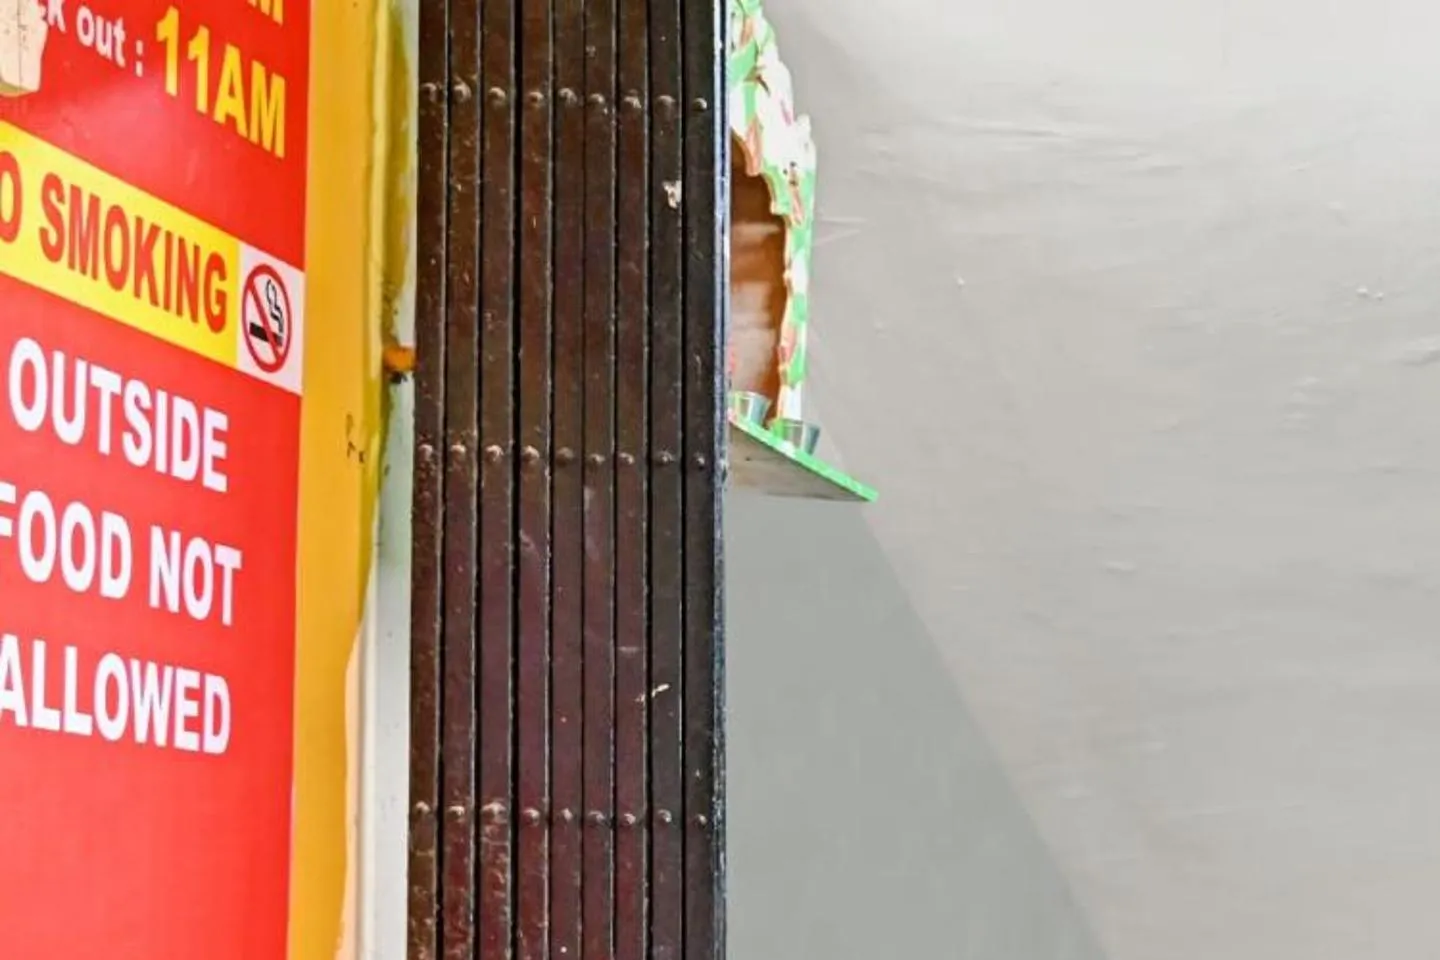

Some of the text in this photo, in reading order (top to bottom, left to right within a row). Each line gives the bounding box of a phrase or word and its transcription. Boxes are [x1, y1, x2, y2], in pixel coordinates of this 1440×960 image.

[156, 5, 286, 159] 11AM
[0, 151, 228, 334] O SMOKING
[9, 337, 229, 493] OUTSIDE
[150, 525, 243, 626] NOT
[0, 634, 232, 755] ALLOWED
